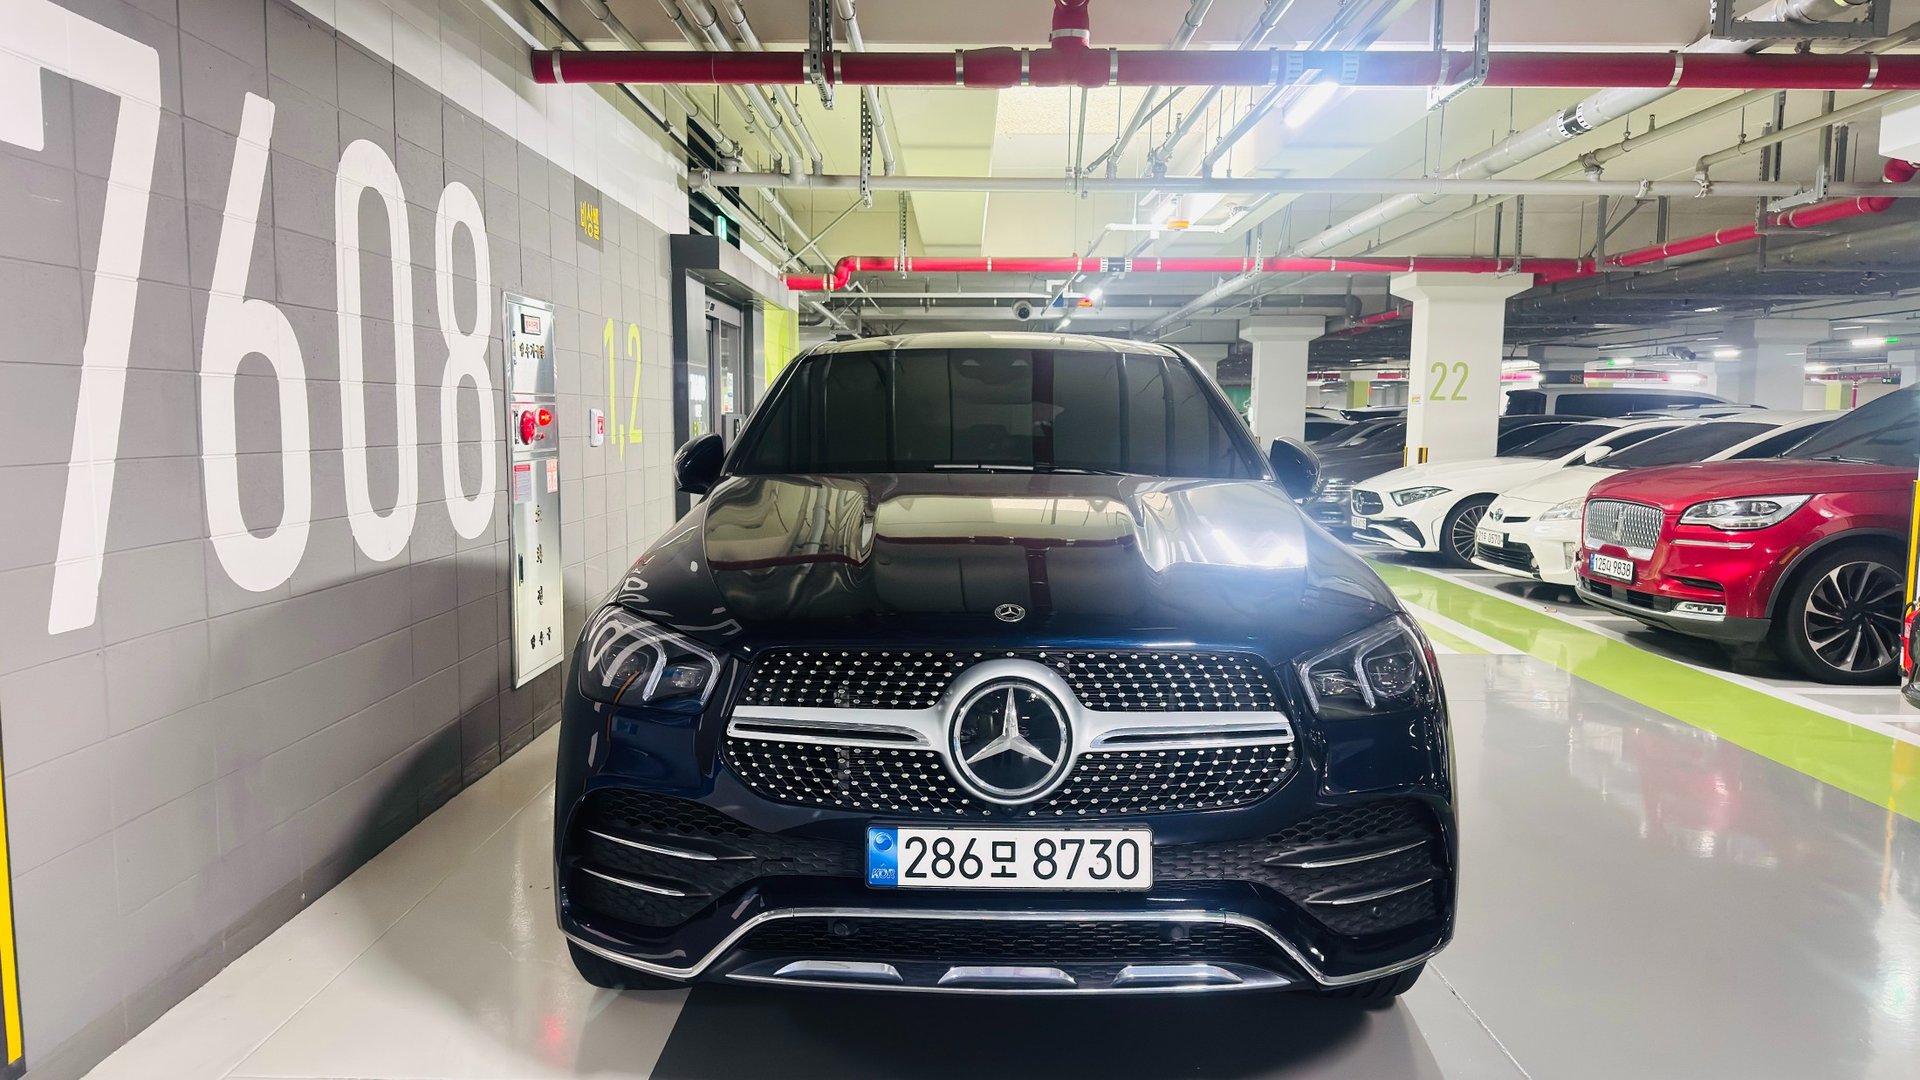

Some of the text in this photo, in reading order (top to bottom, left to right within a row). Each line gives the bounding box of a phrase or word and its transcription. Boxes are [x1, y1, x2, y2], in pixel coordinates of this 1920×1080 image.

[580, 200, 600, 241] 비상벨
[0, 0, 495, 635] 7608
[603, 317, 643, 460] 1,2
[1429, 361, 1469, 401] 22
[1613, 560, 1631, 577] 9838
[871, 868, 896, 880] KOR
[904, 836, 1140, 880] 286모 8730
